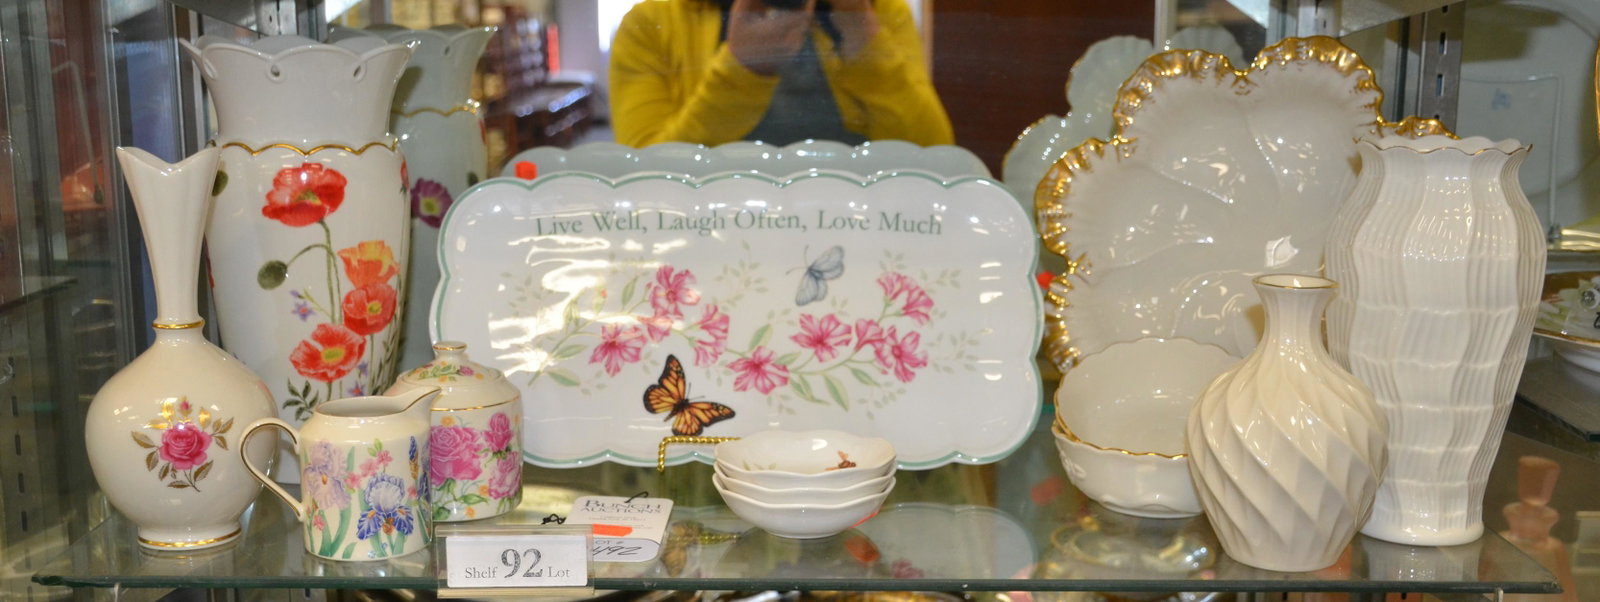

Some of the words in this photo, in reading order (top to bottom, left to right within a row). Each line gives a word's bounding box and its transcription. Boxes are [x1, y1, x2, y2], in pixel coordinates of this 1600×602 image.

[536, 216, 583, 237] Live
[592, 210, 647, 233] Well,
[657, 210, 726, 237] Laugh
[734, 209, 807, 232] Often,
[816, 210, 871, 231] Love
[878, 211, 942, 235] Much
[585, 499, 662, 509] BUNCH
[465, 566, 498, 579] Shelf
[501, 548, 543, 579] 92
[547, 566, 571, 578] Lot
